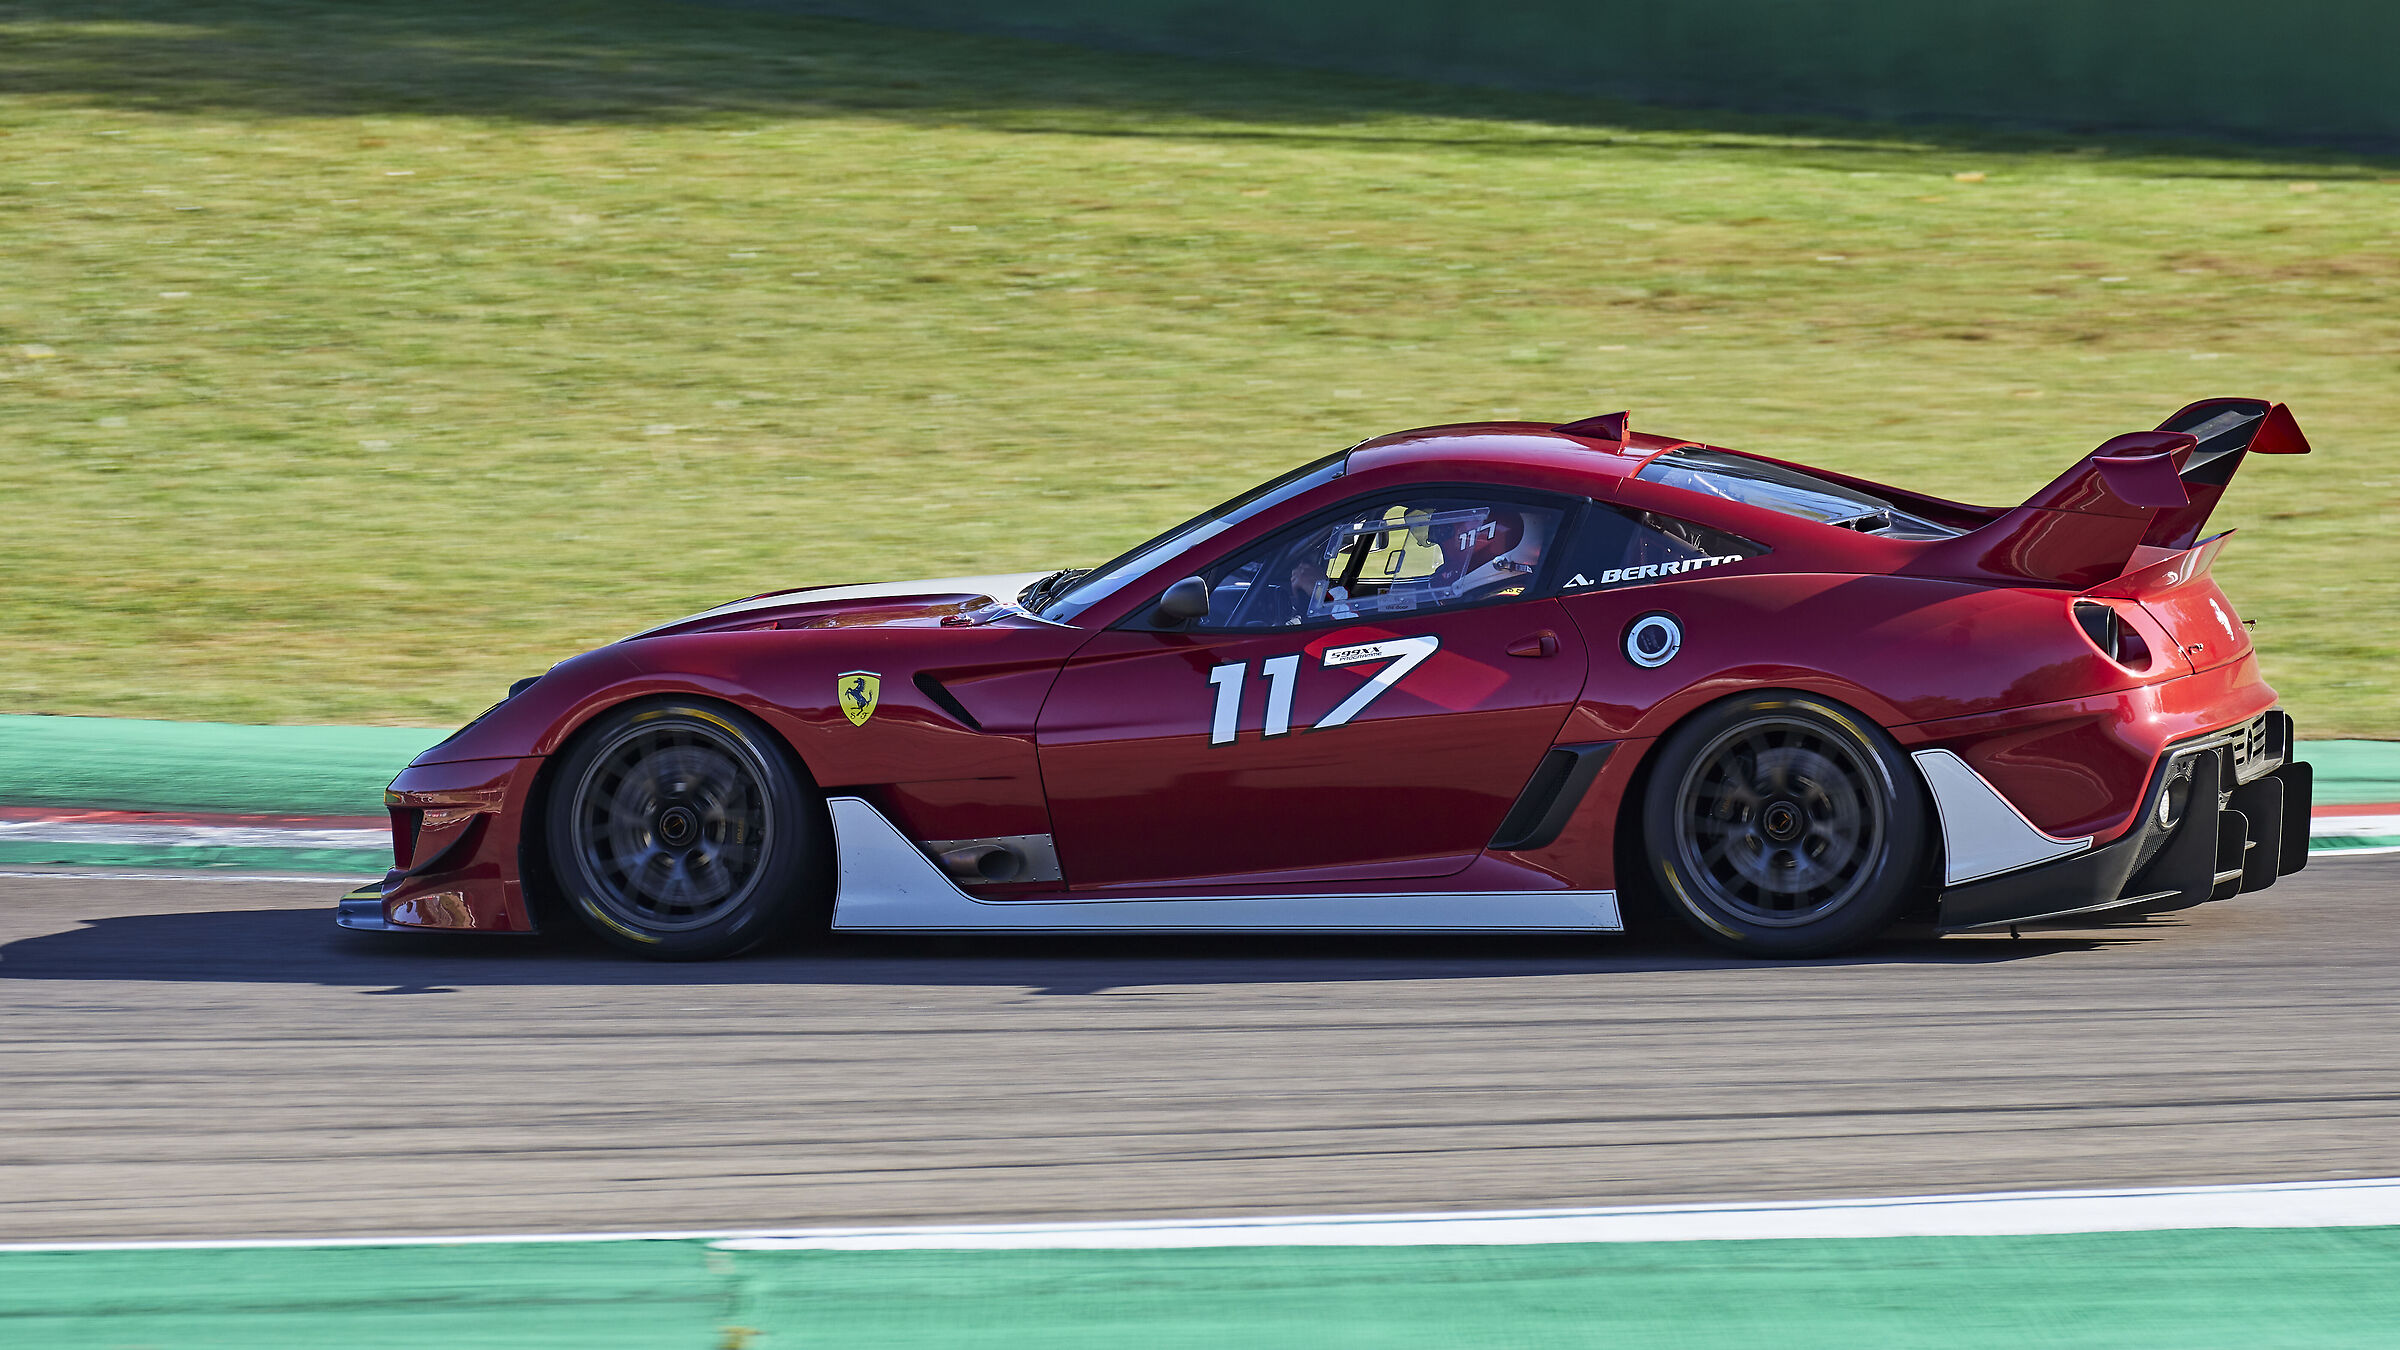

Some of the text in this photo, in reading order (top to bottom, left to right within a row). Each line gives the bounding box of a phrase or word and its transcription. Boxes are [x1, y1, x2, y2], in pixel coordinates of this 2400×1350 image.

[1459, 520, 1497, 551] 117
[1563, 573, 1595, 588] A.
[1331, 645, 1382, 659] 599XX
[1208, 634, 1440, 746] 117
